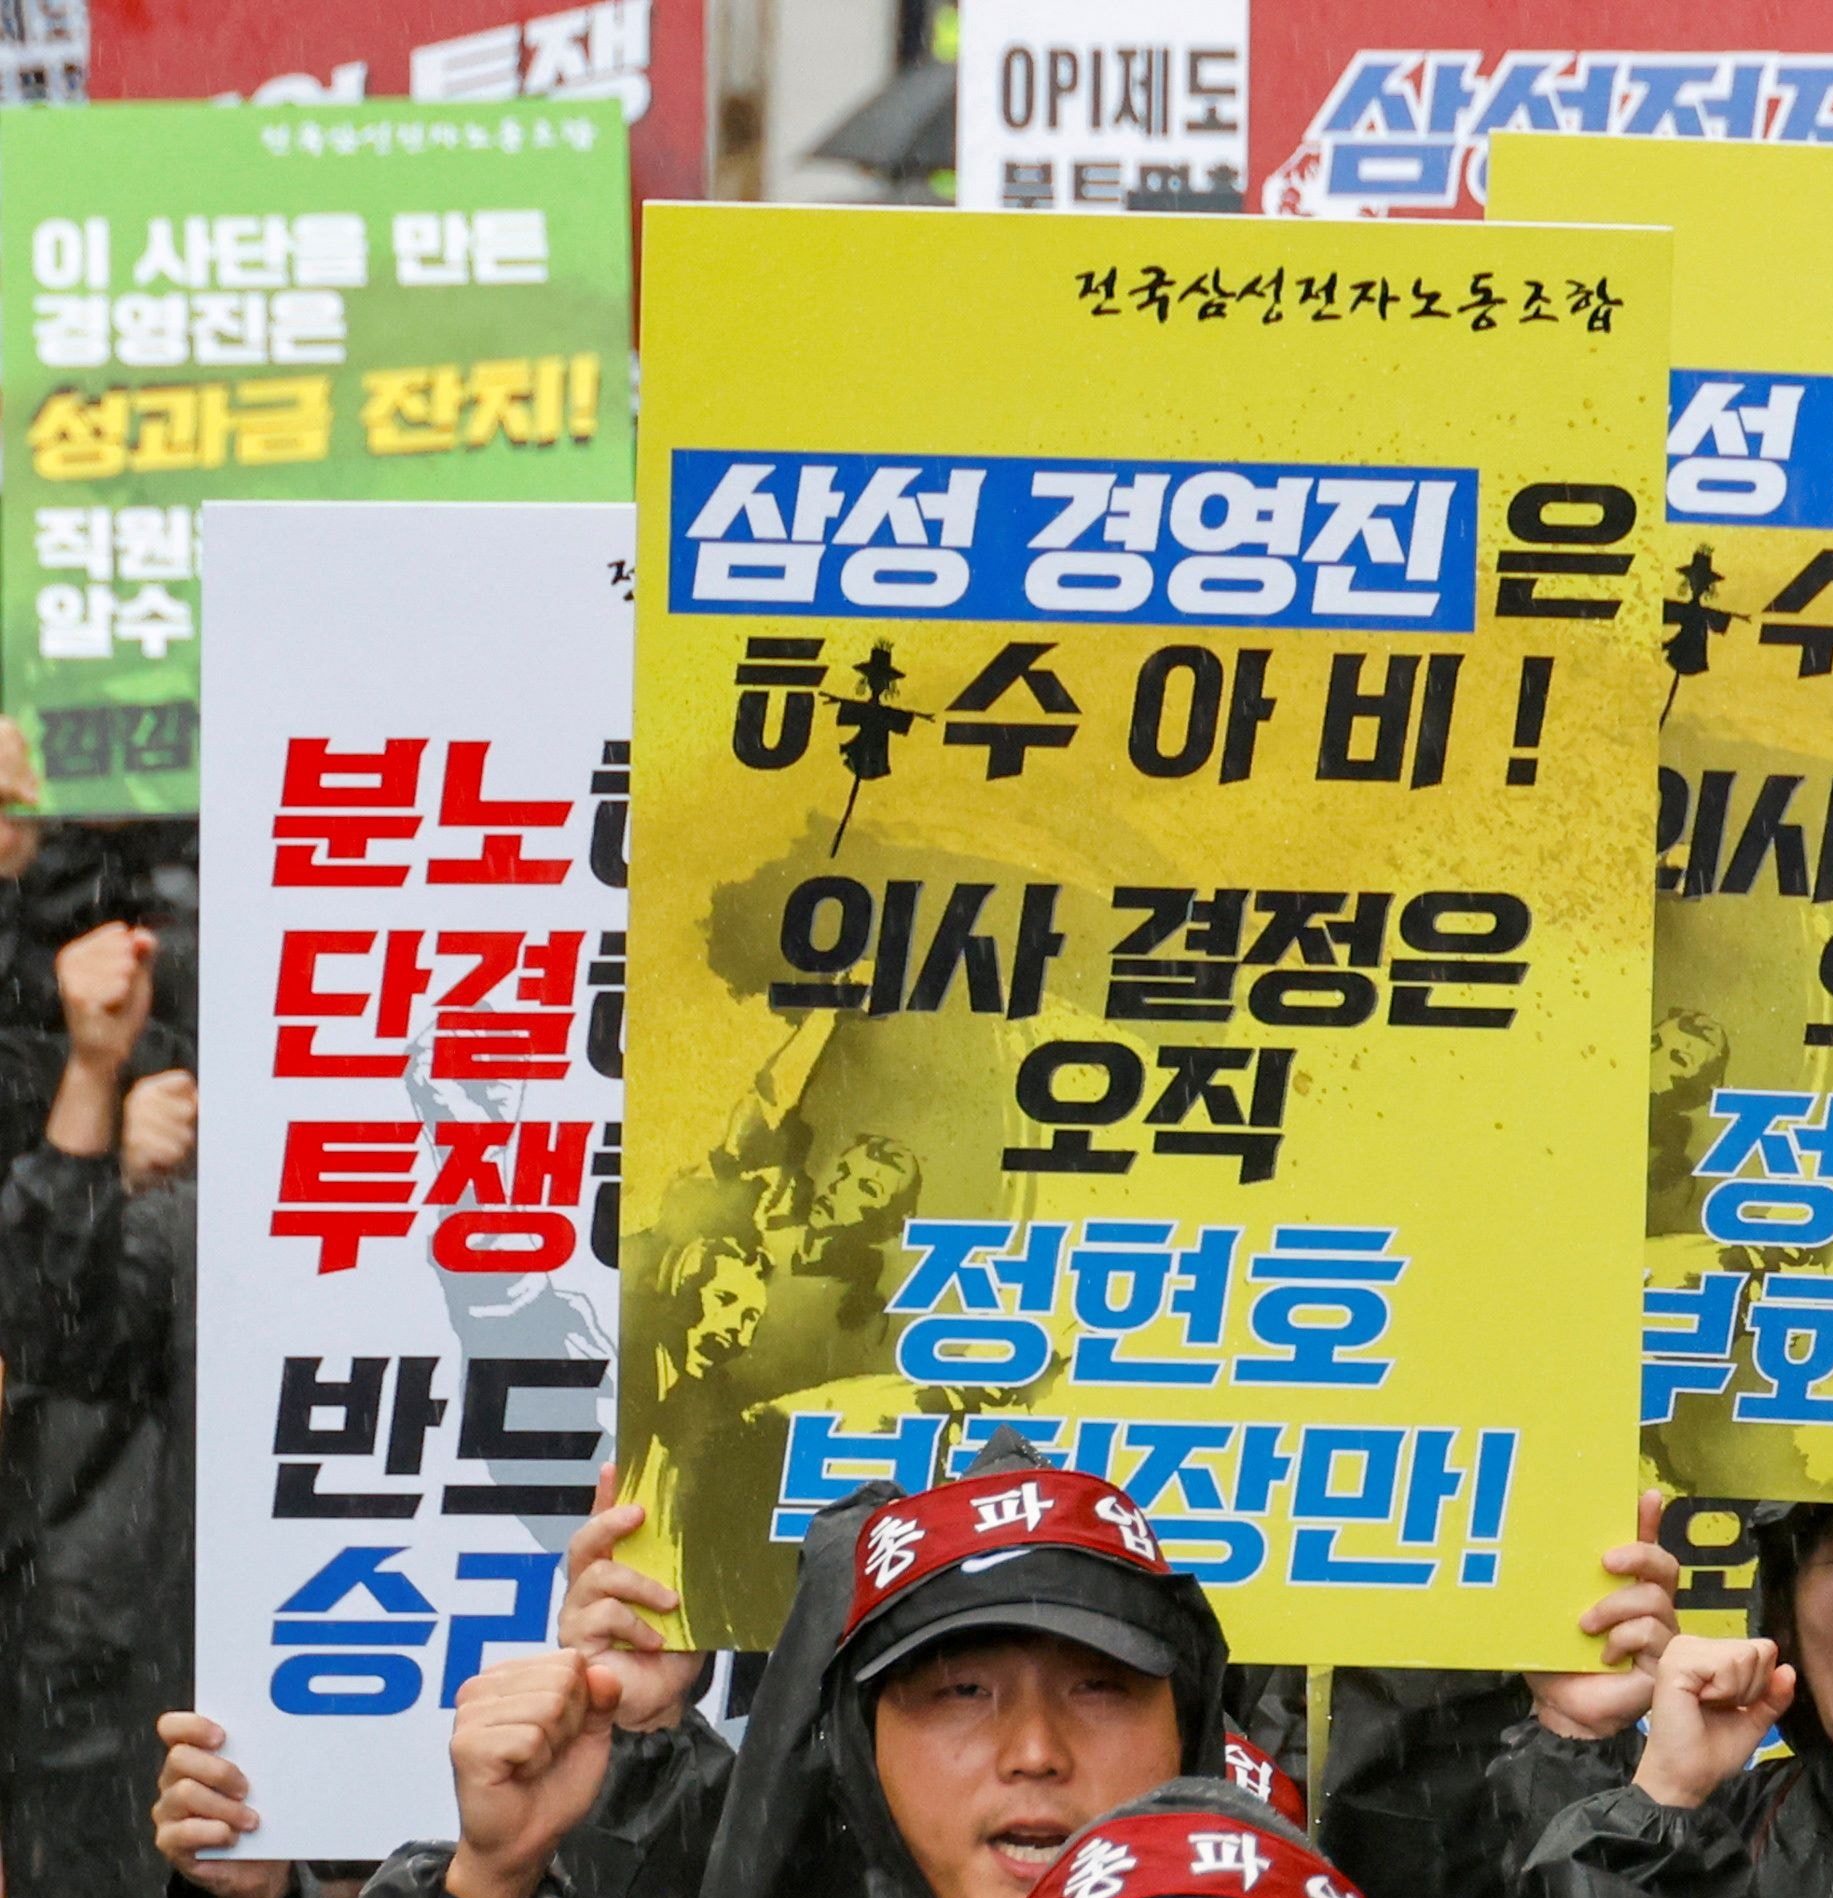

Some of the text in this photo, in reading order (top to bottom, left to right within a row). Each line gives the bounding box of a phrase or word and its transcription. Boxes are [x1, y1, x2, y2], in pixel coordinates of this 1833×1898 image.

[33, 209, 548, 287] 이 사단을 만든
[1075, 264, 1625, 335] 전국삼성전자노동조합
[34, 290, 347, 366] 경영진은
[27, 353, 600, 482] 성과금 잔치!
[1666, 382, 1806, 516] 성
[33, 504, 203, 580] 직원
[684, 462, 987, 609] 삼성
[272, 930, 626, 1079] 단결
[768, 876, 1530, 1029] 의사 결정은
[1001, 1039, 1296, 1184] 오직
[269, 1121, 622, 1275] 투쟁
[883, 1218, 1409, 1387] 정현호
[768, 1414, 1519, 1589] 부장만!
[865, 1482, 1158, 1589] 총파업
